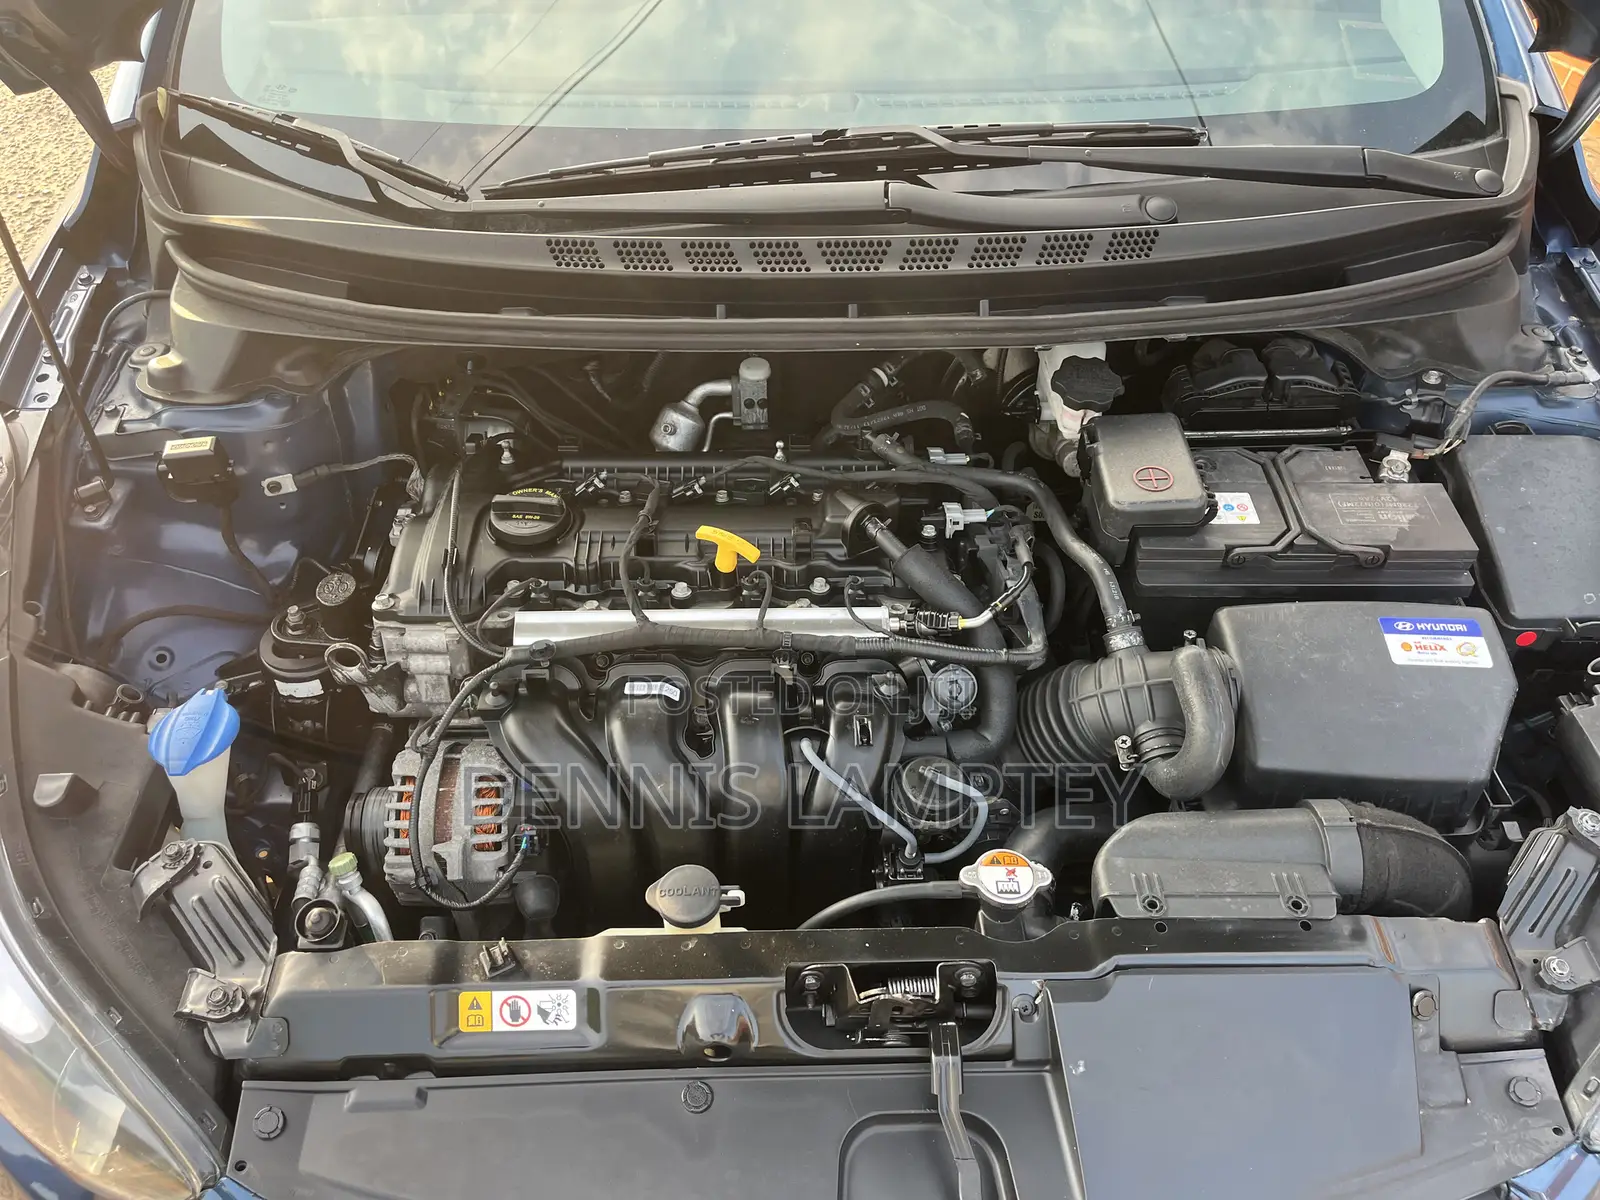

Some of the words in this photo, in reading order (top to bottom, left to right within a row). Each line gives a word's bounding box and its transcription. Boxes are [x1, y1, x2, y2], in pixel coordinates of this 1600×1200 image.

[512, 487, 544, 496] OWNER'S
[1416, 622, 1468, 632] HYUNDAI
[1414, 643, 1448, 653] HELIX
[660, 885, 718, 898] COOLANT
